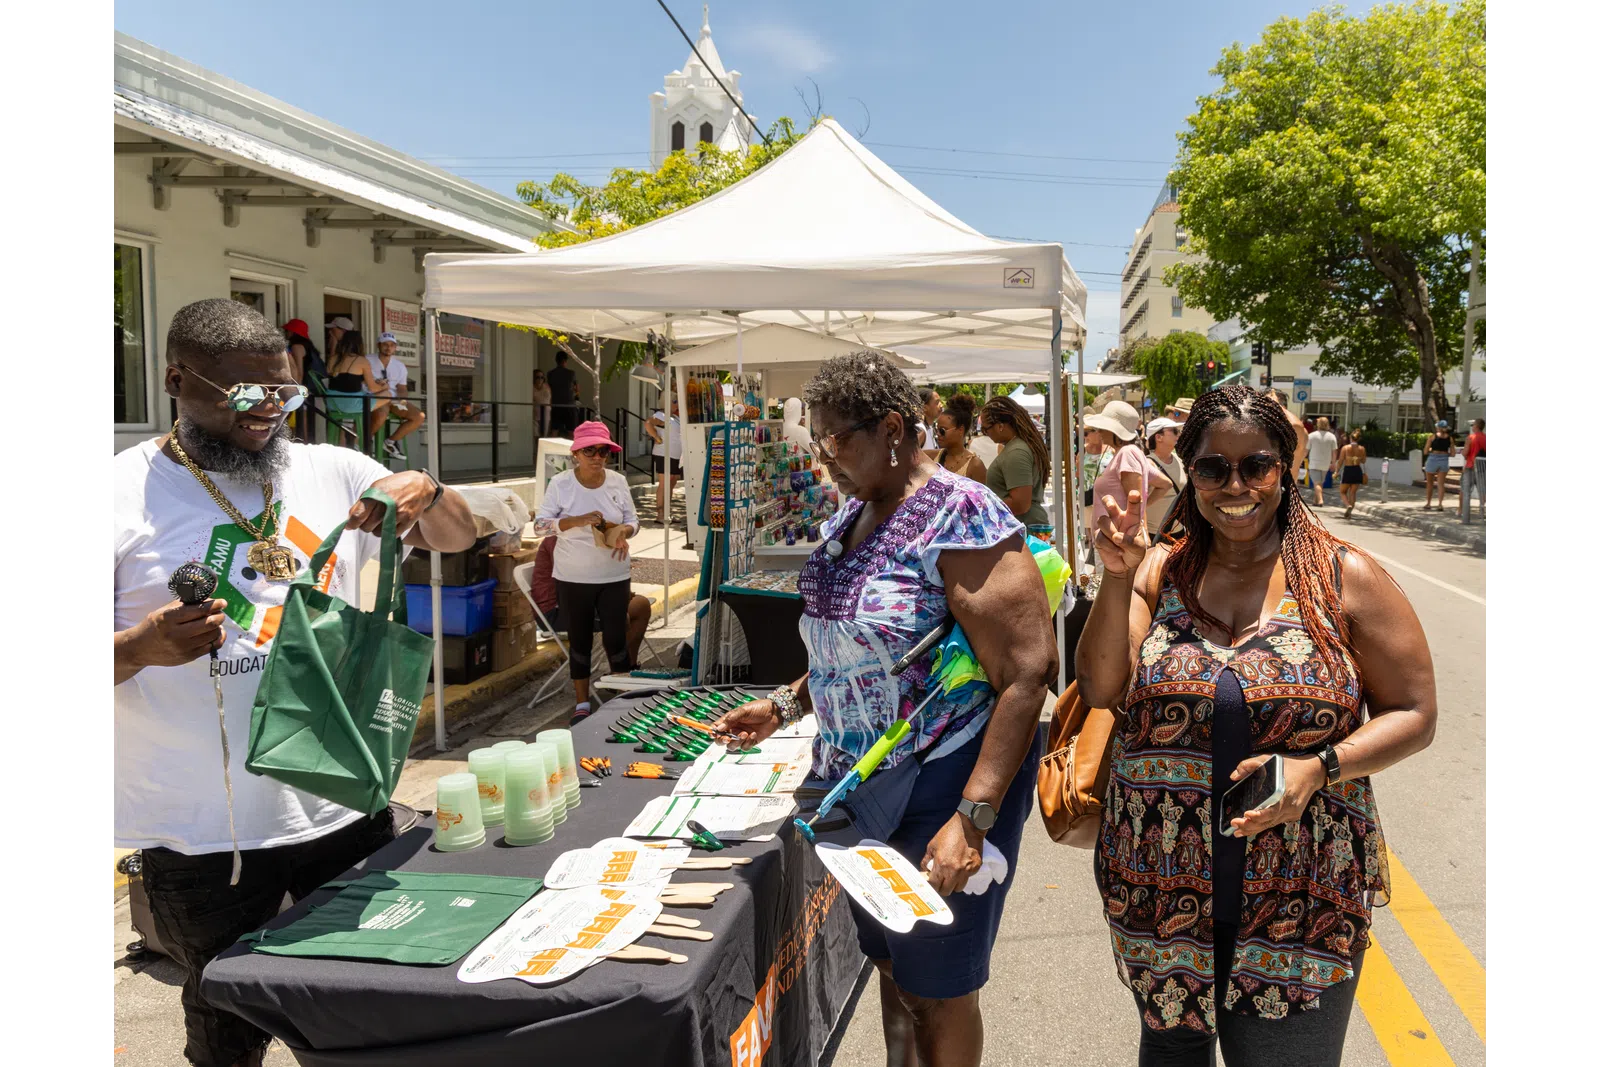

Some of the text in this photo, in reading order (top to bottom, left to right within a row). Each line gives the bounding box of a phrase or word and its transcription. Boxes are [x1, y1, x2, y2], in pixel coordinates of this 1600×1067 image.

[434, 330, 455, 354] BEEF
[454, 334, 481, 358] JERKY
[213, 538, 232, 576] FAMU
